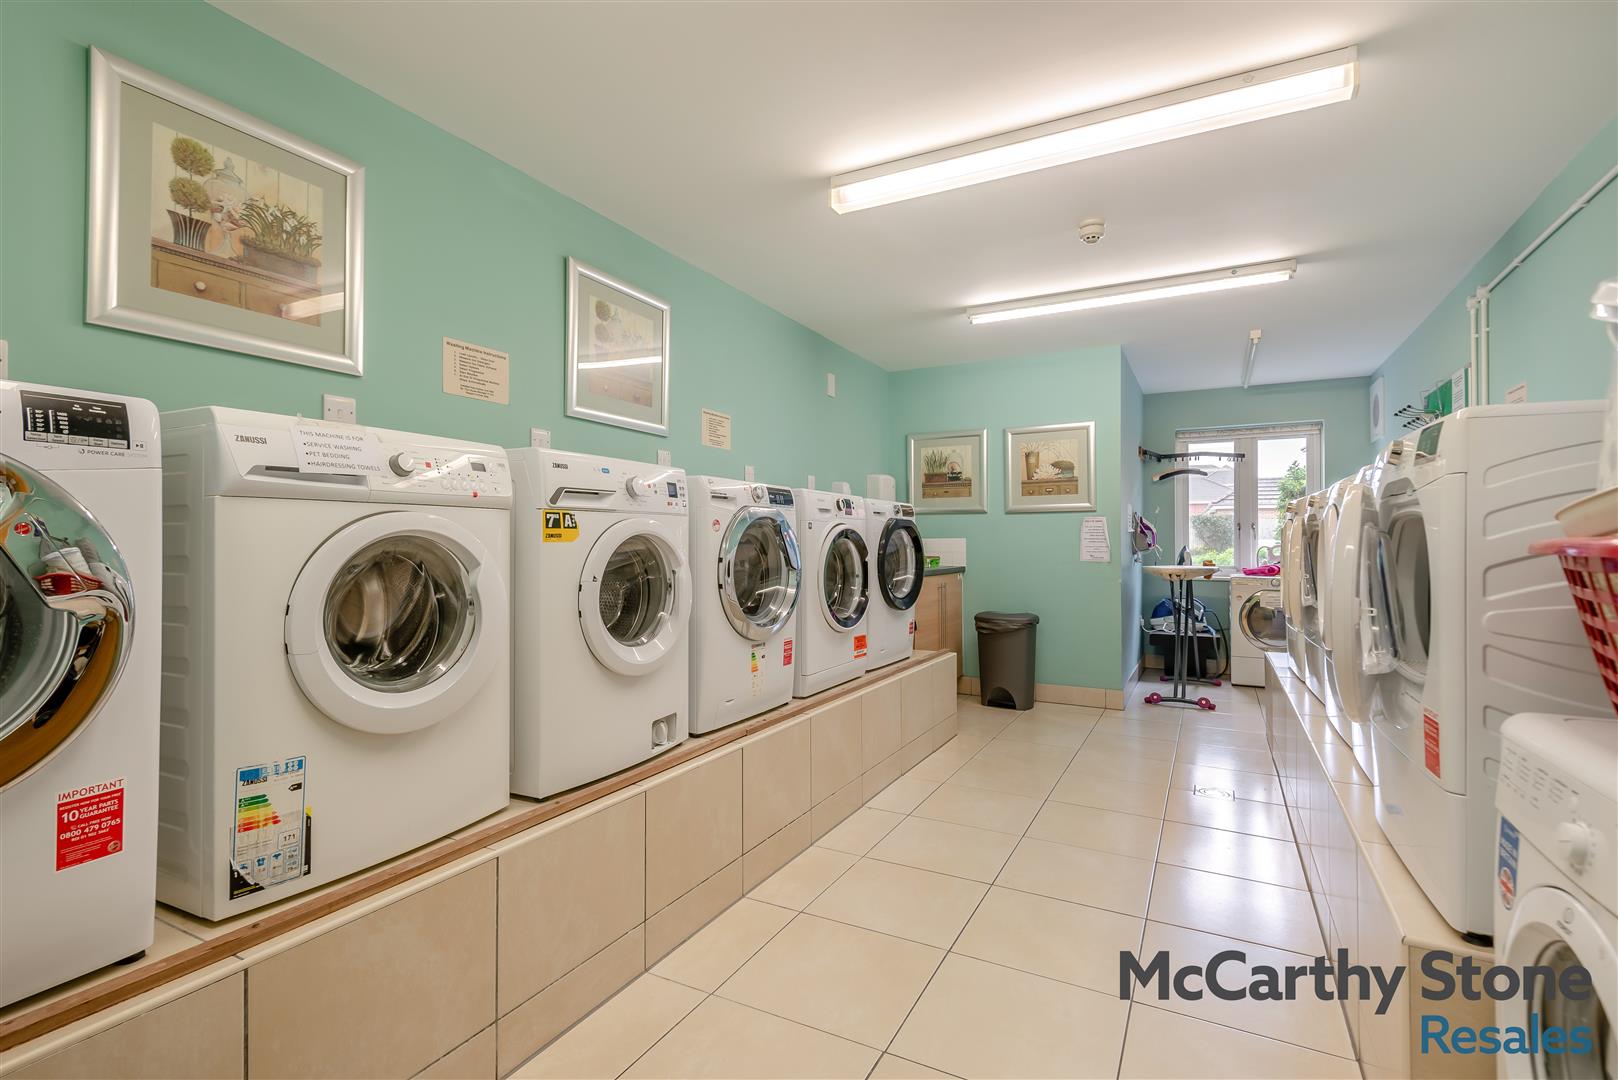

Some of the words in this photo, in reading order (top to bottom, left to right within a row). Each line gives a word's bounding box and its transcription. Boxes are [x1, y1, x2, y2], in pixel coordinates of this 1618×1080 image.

[234, 434, 268, 445] ZANUSSI
[315, 432, 344, 440] MACHINE
[334, 444, 363, 452] WASHING
[322, 452, 350, 460] BEDDING
[310, 460, 356, 470] HAIRDRESSING
[357, 463, 381, 472] TOWELS
[57, 778, 124, 801] IMPORTANT
[61, 809, 79, 823] 10
[80, 804, 98, 813] YEAR
[99, 799, 119, 808] PARTS
[79, 804, 119, 819] GUARANTEE
[60, 829, 82, 840] 0800
[83, 824, 99, 834] 479
[101, 818, 121, 829] 0765
